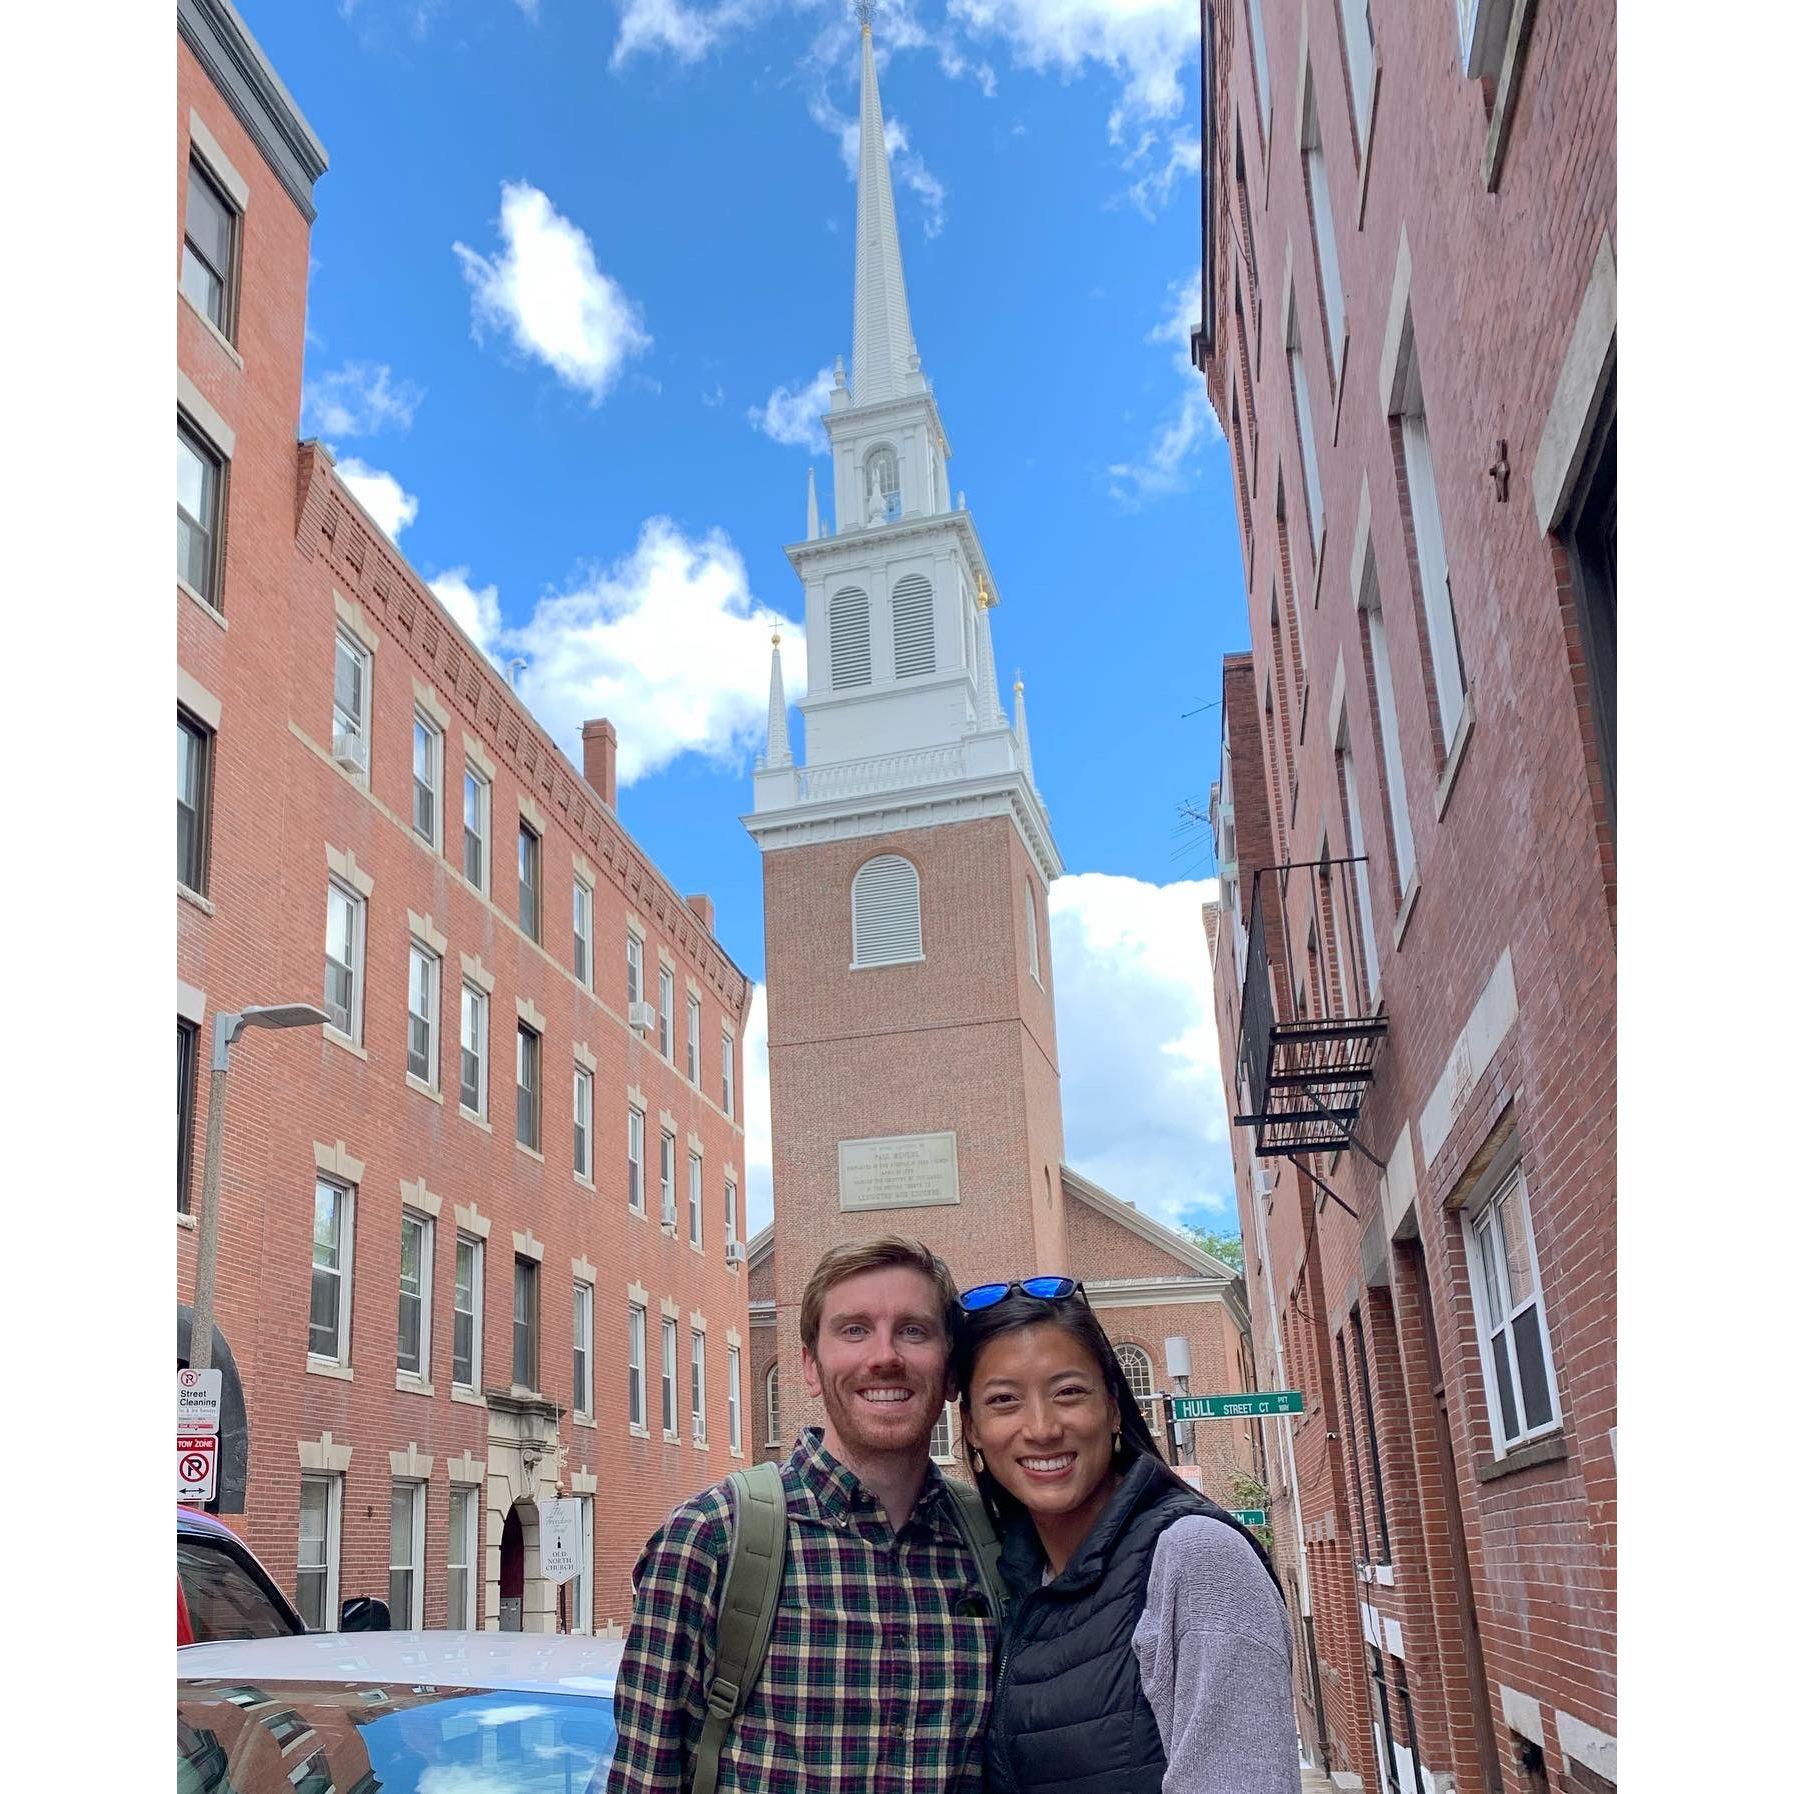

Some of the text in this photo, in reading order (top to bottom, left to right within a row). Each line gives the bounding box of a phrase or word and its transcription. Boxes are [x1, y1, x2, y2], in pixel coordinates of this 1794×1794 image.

[180, 1399, 217, 1407] Cleaning
[1183, 1400, 1270, 1418] HULL STREET CT
[195, 1440, 213, 1448] ZONE
